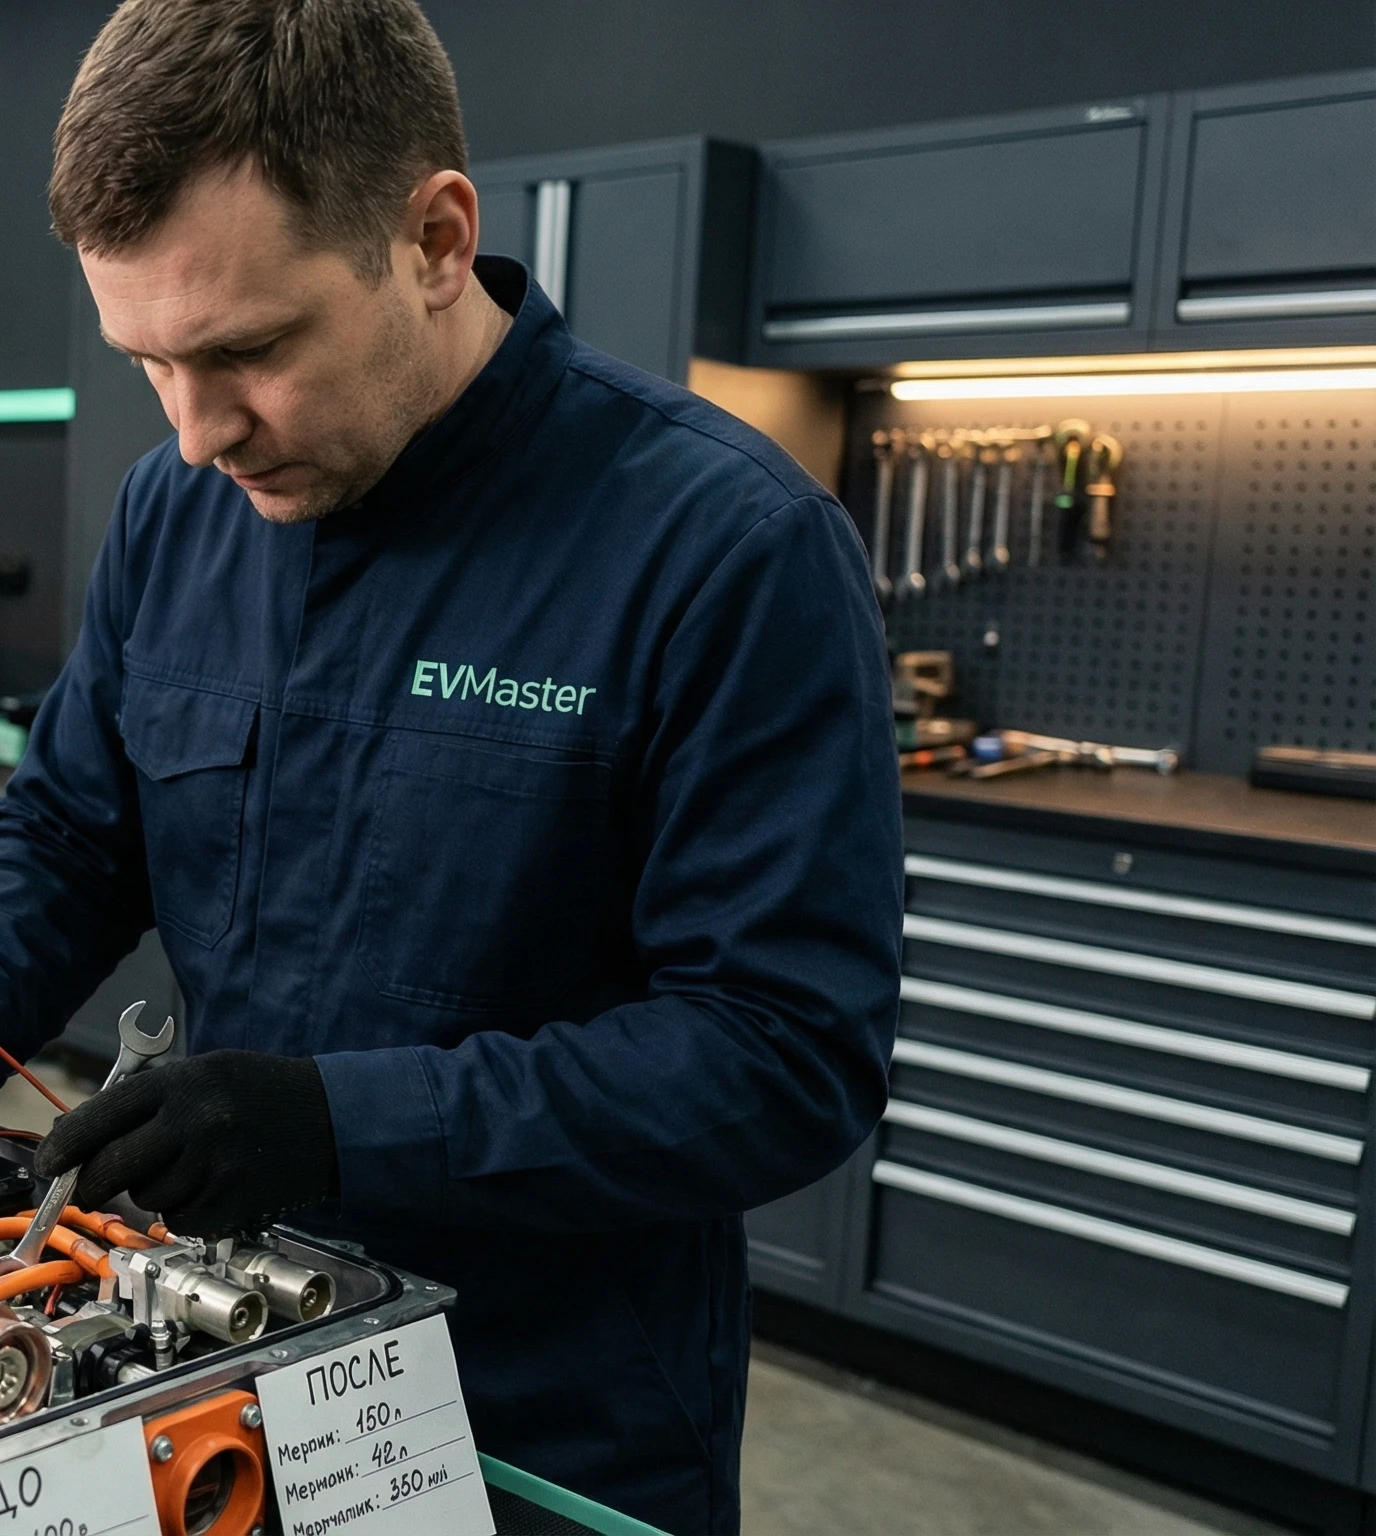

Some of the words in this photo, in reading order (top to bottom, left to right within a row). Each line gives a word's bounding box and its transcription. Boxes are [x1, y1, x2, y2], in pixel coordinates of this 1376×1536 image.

[411, 660, 597, 715] EVMaster
[306, 1339, 404, 1405] ПОСЛЕ
[356, 1402, 390, 1433] 150
[372, 1440, 396, 1467] 42
[390, 1469, 423, 1501] 350
